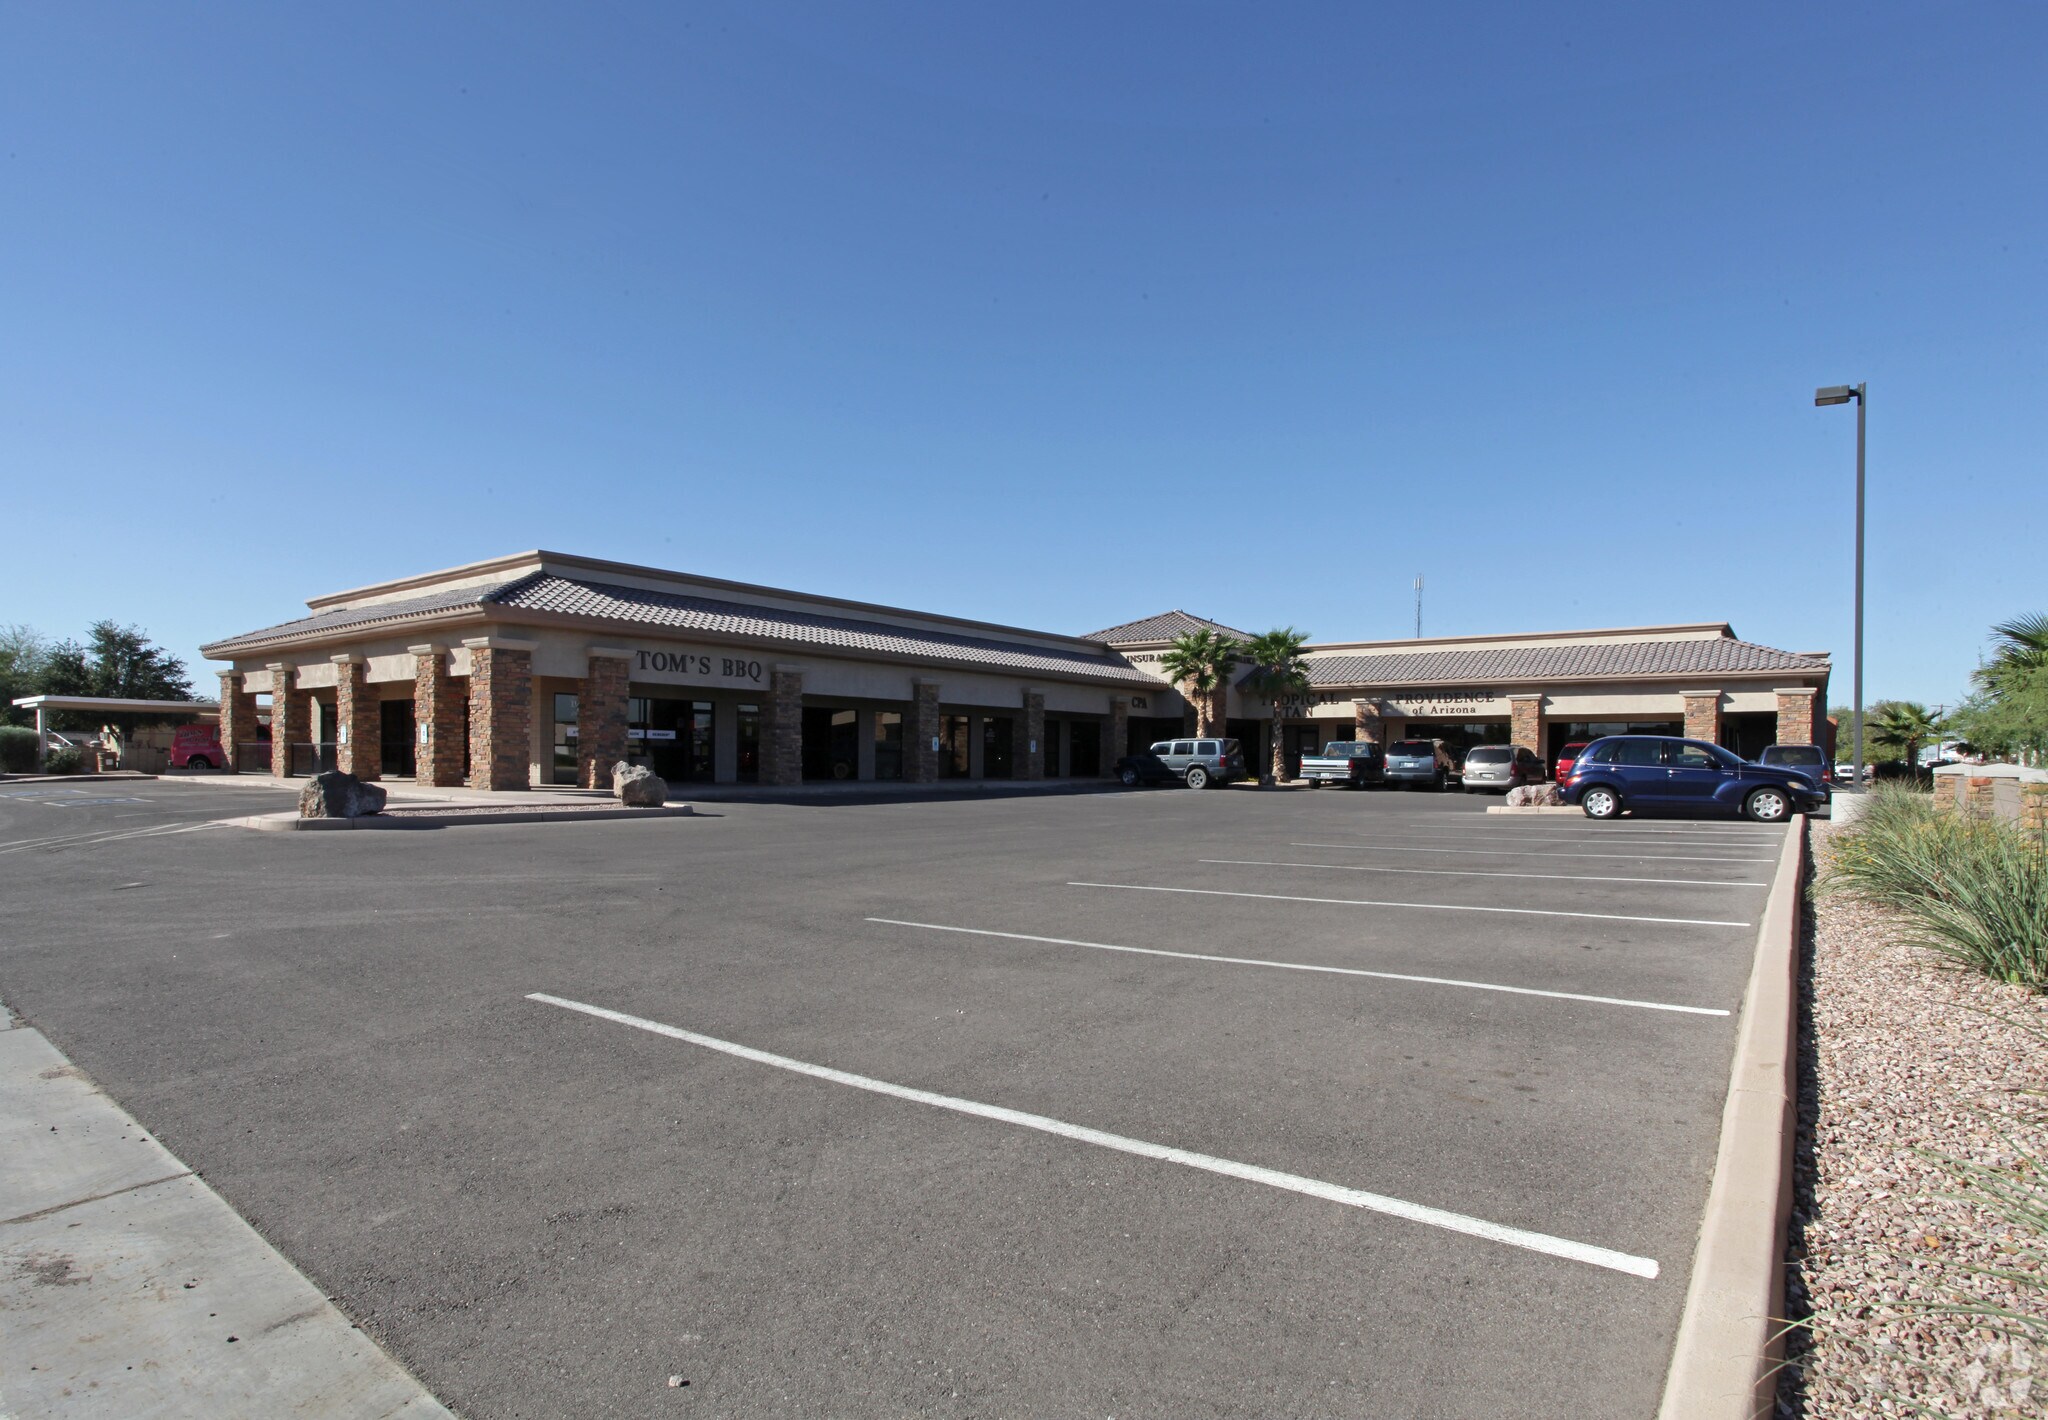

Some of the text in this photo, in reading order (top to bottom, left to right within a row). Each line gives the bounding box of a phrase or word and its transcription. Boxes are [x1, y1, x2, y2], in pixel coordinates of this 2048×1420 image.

[636, 650, 762, 682] TOM'S BBQ
[1132, 697, 1148, 709] CPA
[1396, 692, 1495, 704] PROVIDENCE
[1412, 706, 1476, 714] of Arizona
